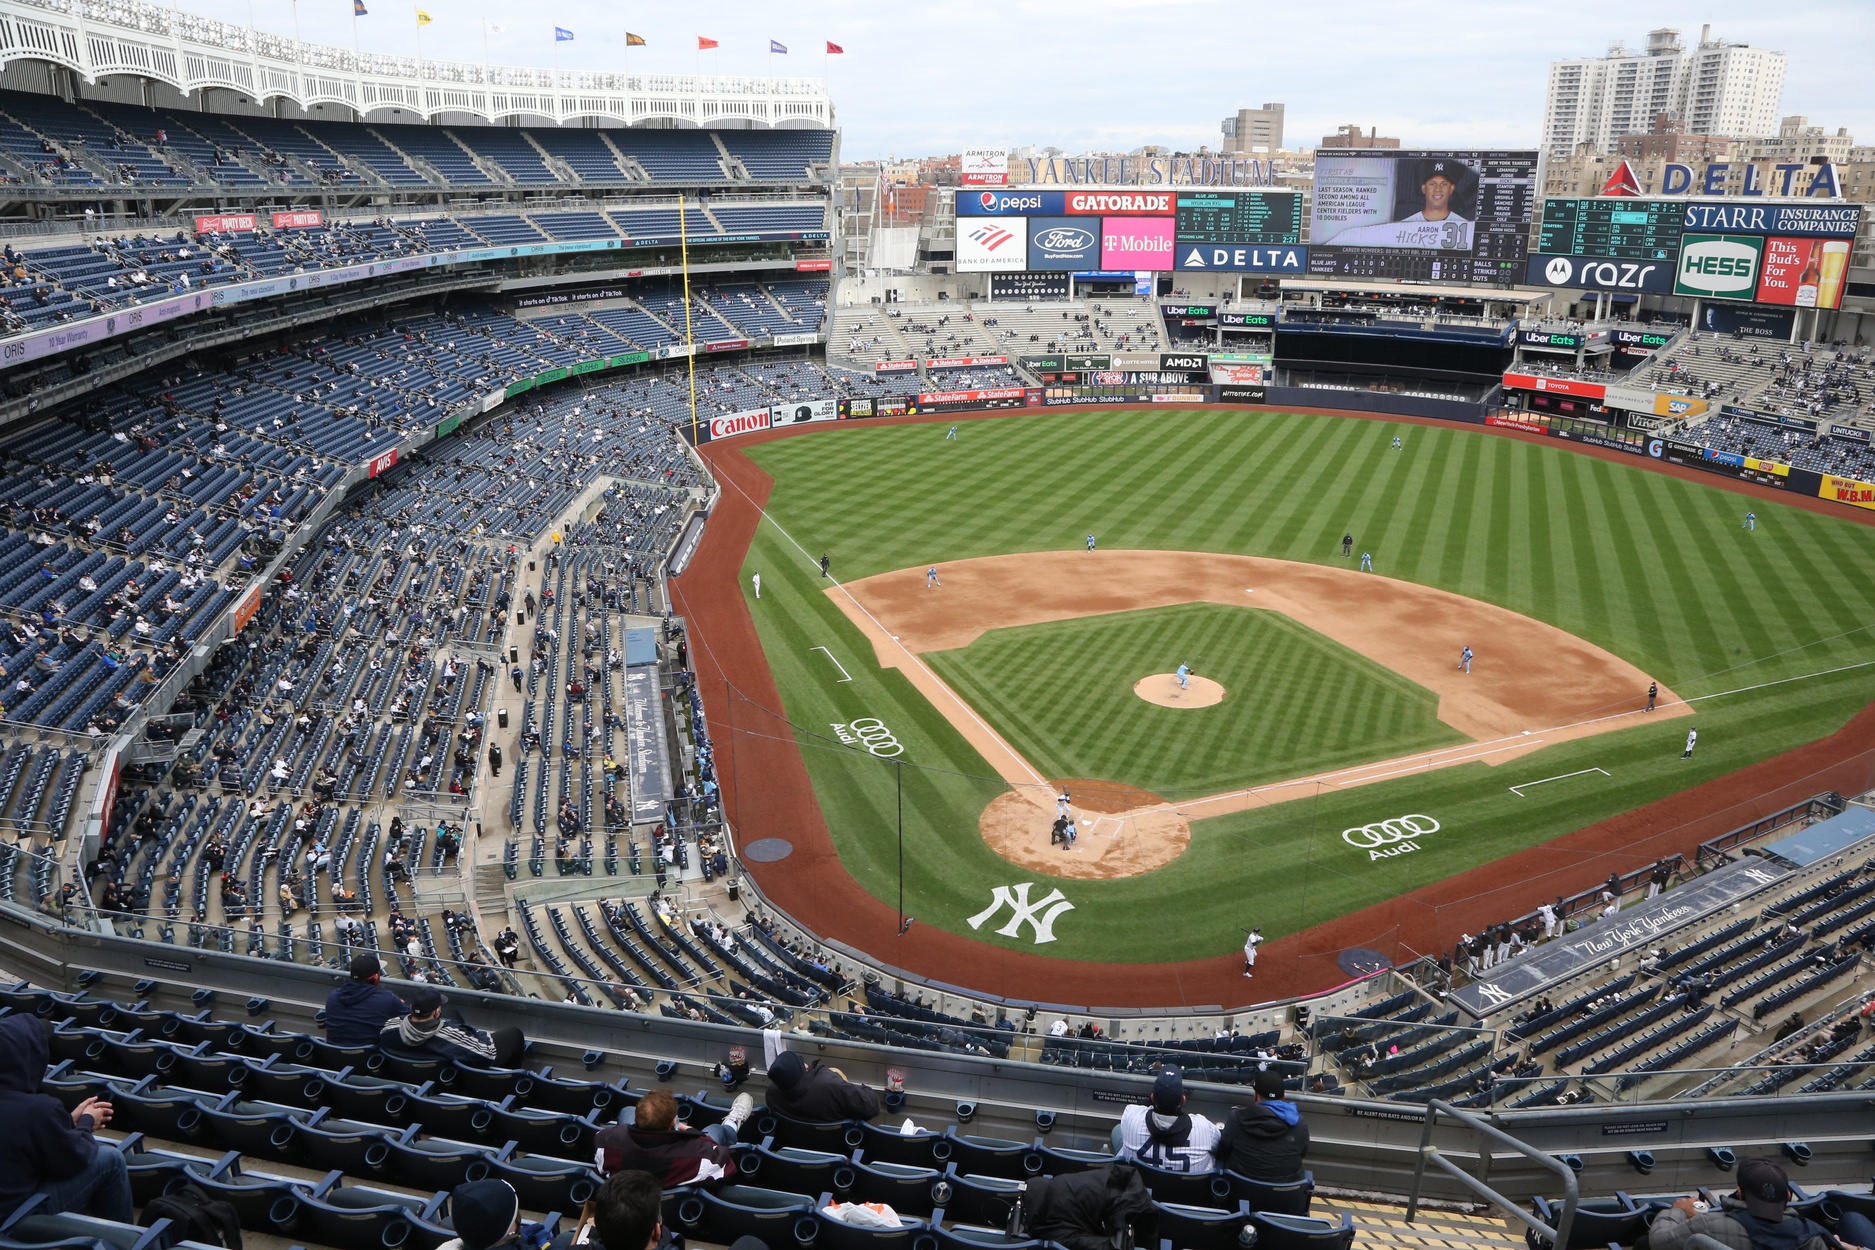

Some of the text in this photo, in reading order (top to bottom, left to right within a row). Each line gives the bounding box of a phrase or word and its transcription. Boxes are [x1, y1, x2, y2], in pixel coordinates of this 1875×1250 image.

[1027, 157, 1275, 188] YANKEE STADIUM
[1662, 163, 1841, 198] DELTA
[1000, 195, 1042, 211] pepsi
[1072, 195, 1171, 211] GATORADE
[293, 214, 320, 225] PARTY DECK
[1684, 205, 1768, 230] STARR
[1779, 208, 1860, 222] INSURANCE
[1417, 226, 1439, 234] AARON
[1777, 219, 1857, 233] COMPANIES
[1043, 230, 1085, 249] Ford
[1282, 236, 1298, 244] 2:21
[1395, 230, 1438, 247] HICKS
[1440, 221, 1468, 250] 31
[1119, 234, 1173, 252] Mobile
[1769, 241, 1797, 253] This
[1213, 249, 1299, 267] DELTA
[1768, 253, 1801, 265] Bud's
[1473, 267, 1498, 275] STRIKES
[1685, 255, 1752, 277] HESS
[1765, 264, 1787, 277] For
[1580, 261, 1656, 289] razr
[1764, 276, 1789, 289] You.
[210, 291, 225, 302] ORIS
[241, 287, 249, 297] The
[258, 284, 275, 295] standard
[1167, 306, 1209, 315] Uber Eats
[128, 311, 143, 324] ORIS
[1223, 315, 1268, 325] Uber Eats
[1739, 326, 1773, 336] THE BOSS
[4, 329, 89, 359] ORIS 10 Year Warranty
[776, 336, 796, 346] Poland
[1525, 332, 1575, 345] Uber Eats
[1619, 332, 1667, 345] Uber Eats
[887, 361, 914, 370] StateFarm
[939, 359, 964, 367] StateFarm
[979, 357, 1003, 365] StateFarm
[1041, 360, 1058, 368] Eats
[1165, 358, 1194, 368] AMD
[1130, 373, 1137, 384] A
[1139, 373, 1157, 384] SUB
[1160, 372, 1190, 384] ABOVE
[1547, 383, 1570, 391] TOYOTA
[934, 393, 968, 402] StateFarm
[986, 390, 1020, 400] StateFarm
[1072, 396, 1098, 404] StubHub
[1222, 391, 1264, 399] NITTOTIRE.COM
[850, 403, 872, 411] SELTZER
[1590, 404, 1609, 414] FedEx
[1668, 402, 1687, 413] SAP
[711, 412, 770, 437] Canon
[1832, 426, 1863, 438] UNTUCKit
[1583, 436, 1642, 454] StubHub StubHub StubHub
[1648, 439, 1664, 458] G
[375, 453, 392, 474] AVIS
[1720, 453, 1738, 463] pepsi
[829, 723, 859, 745] Audi
[638, 747, 653, 774] Stadium
[1368, 839, 1422, 862] Audi
[1575, 905, 1691, 956] New York Yankees
[1136, 1139, 1191, 1173] 45
